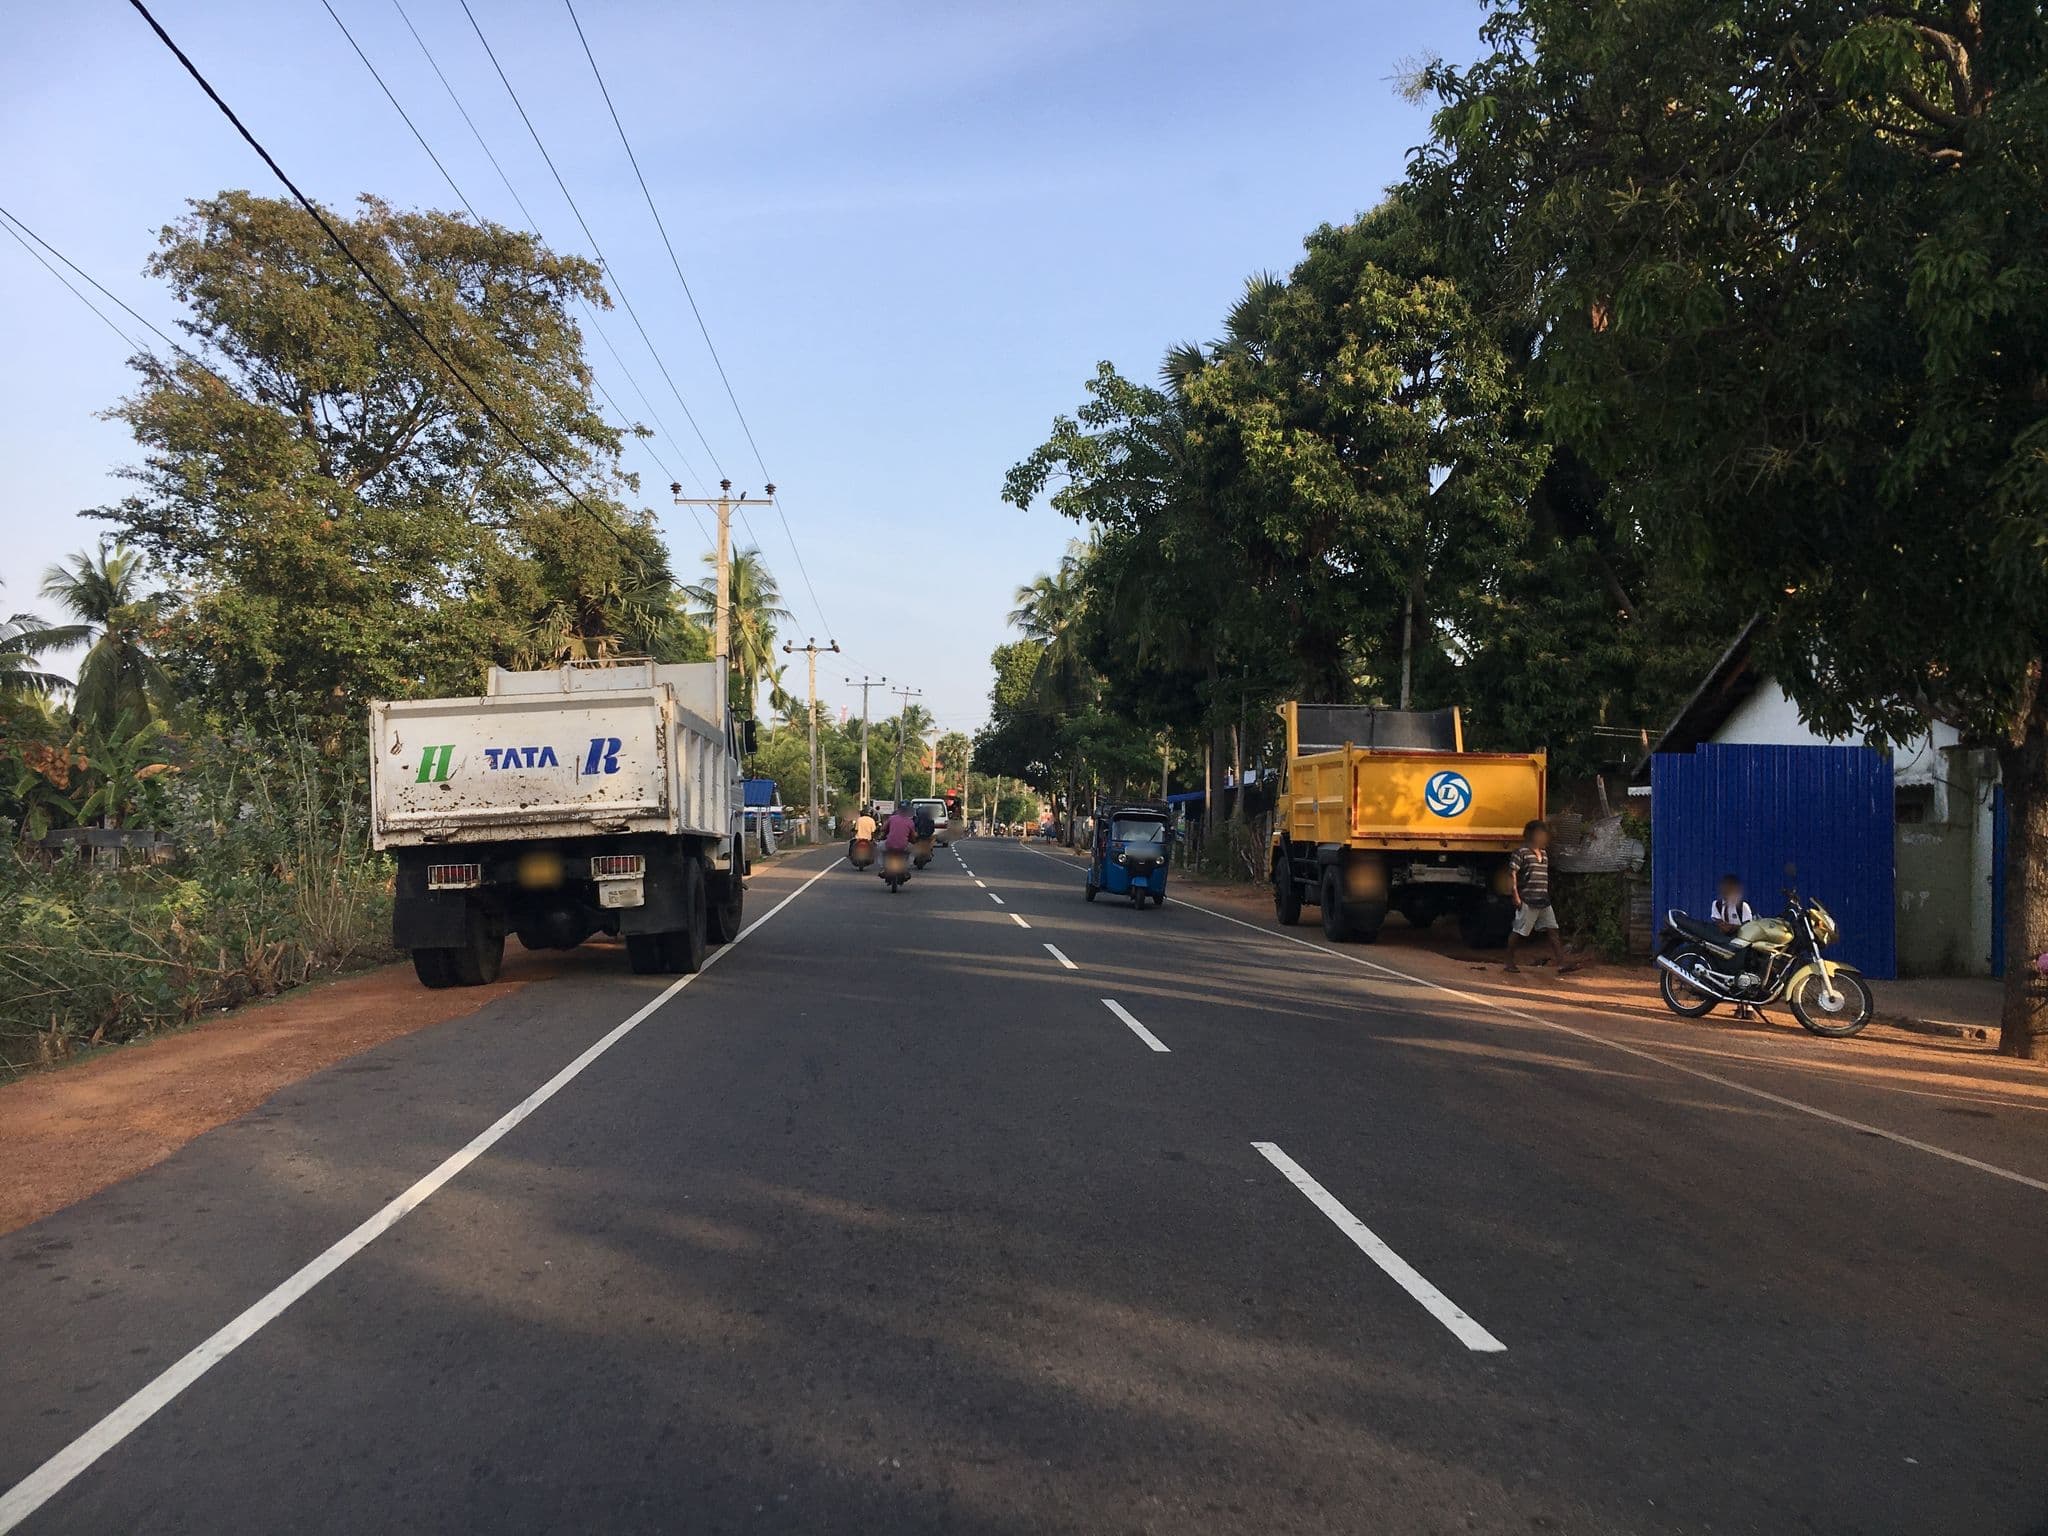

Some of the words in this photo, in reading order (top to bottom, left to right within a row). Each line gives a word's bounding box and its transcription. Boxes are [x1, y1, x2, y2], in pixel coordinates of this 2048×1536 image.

[415, 744, 456, 783] H
[484, 746, 559, 770] TATA
[581, 737, 622, 775] R
[1442, 787, 1456, 800] L
